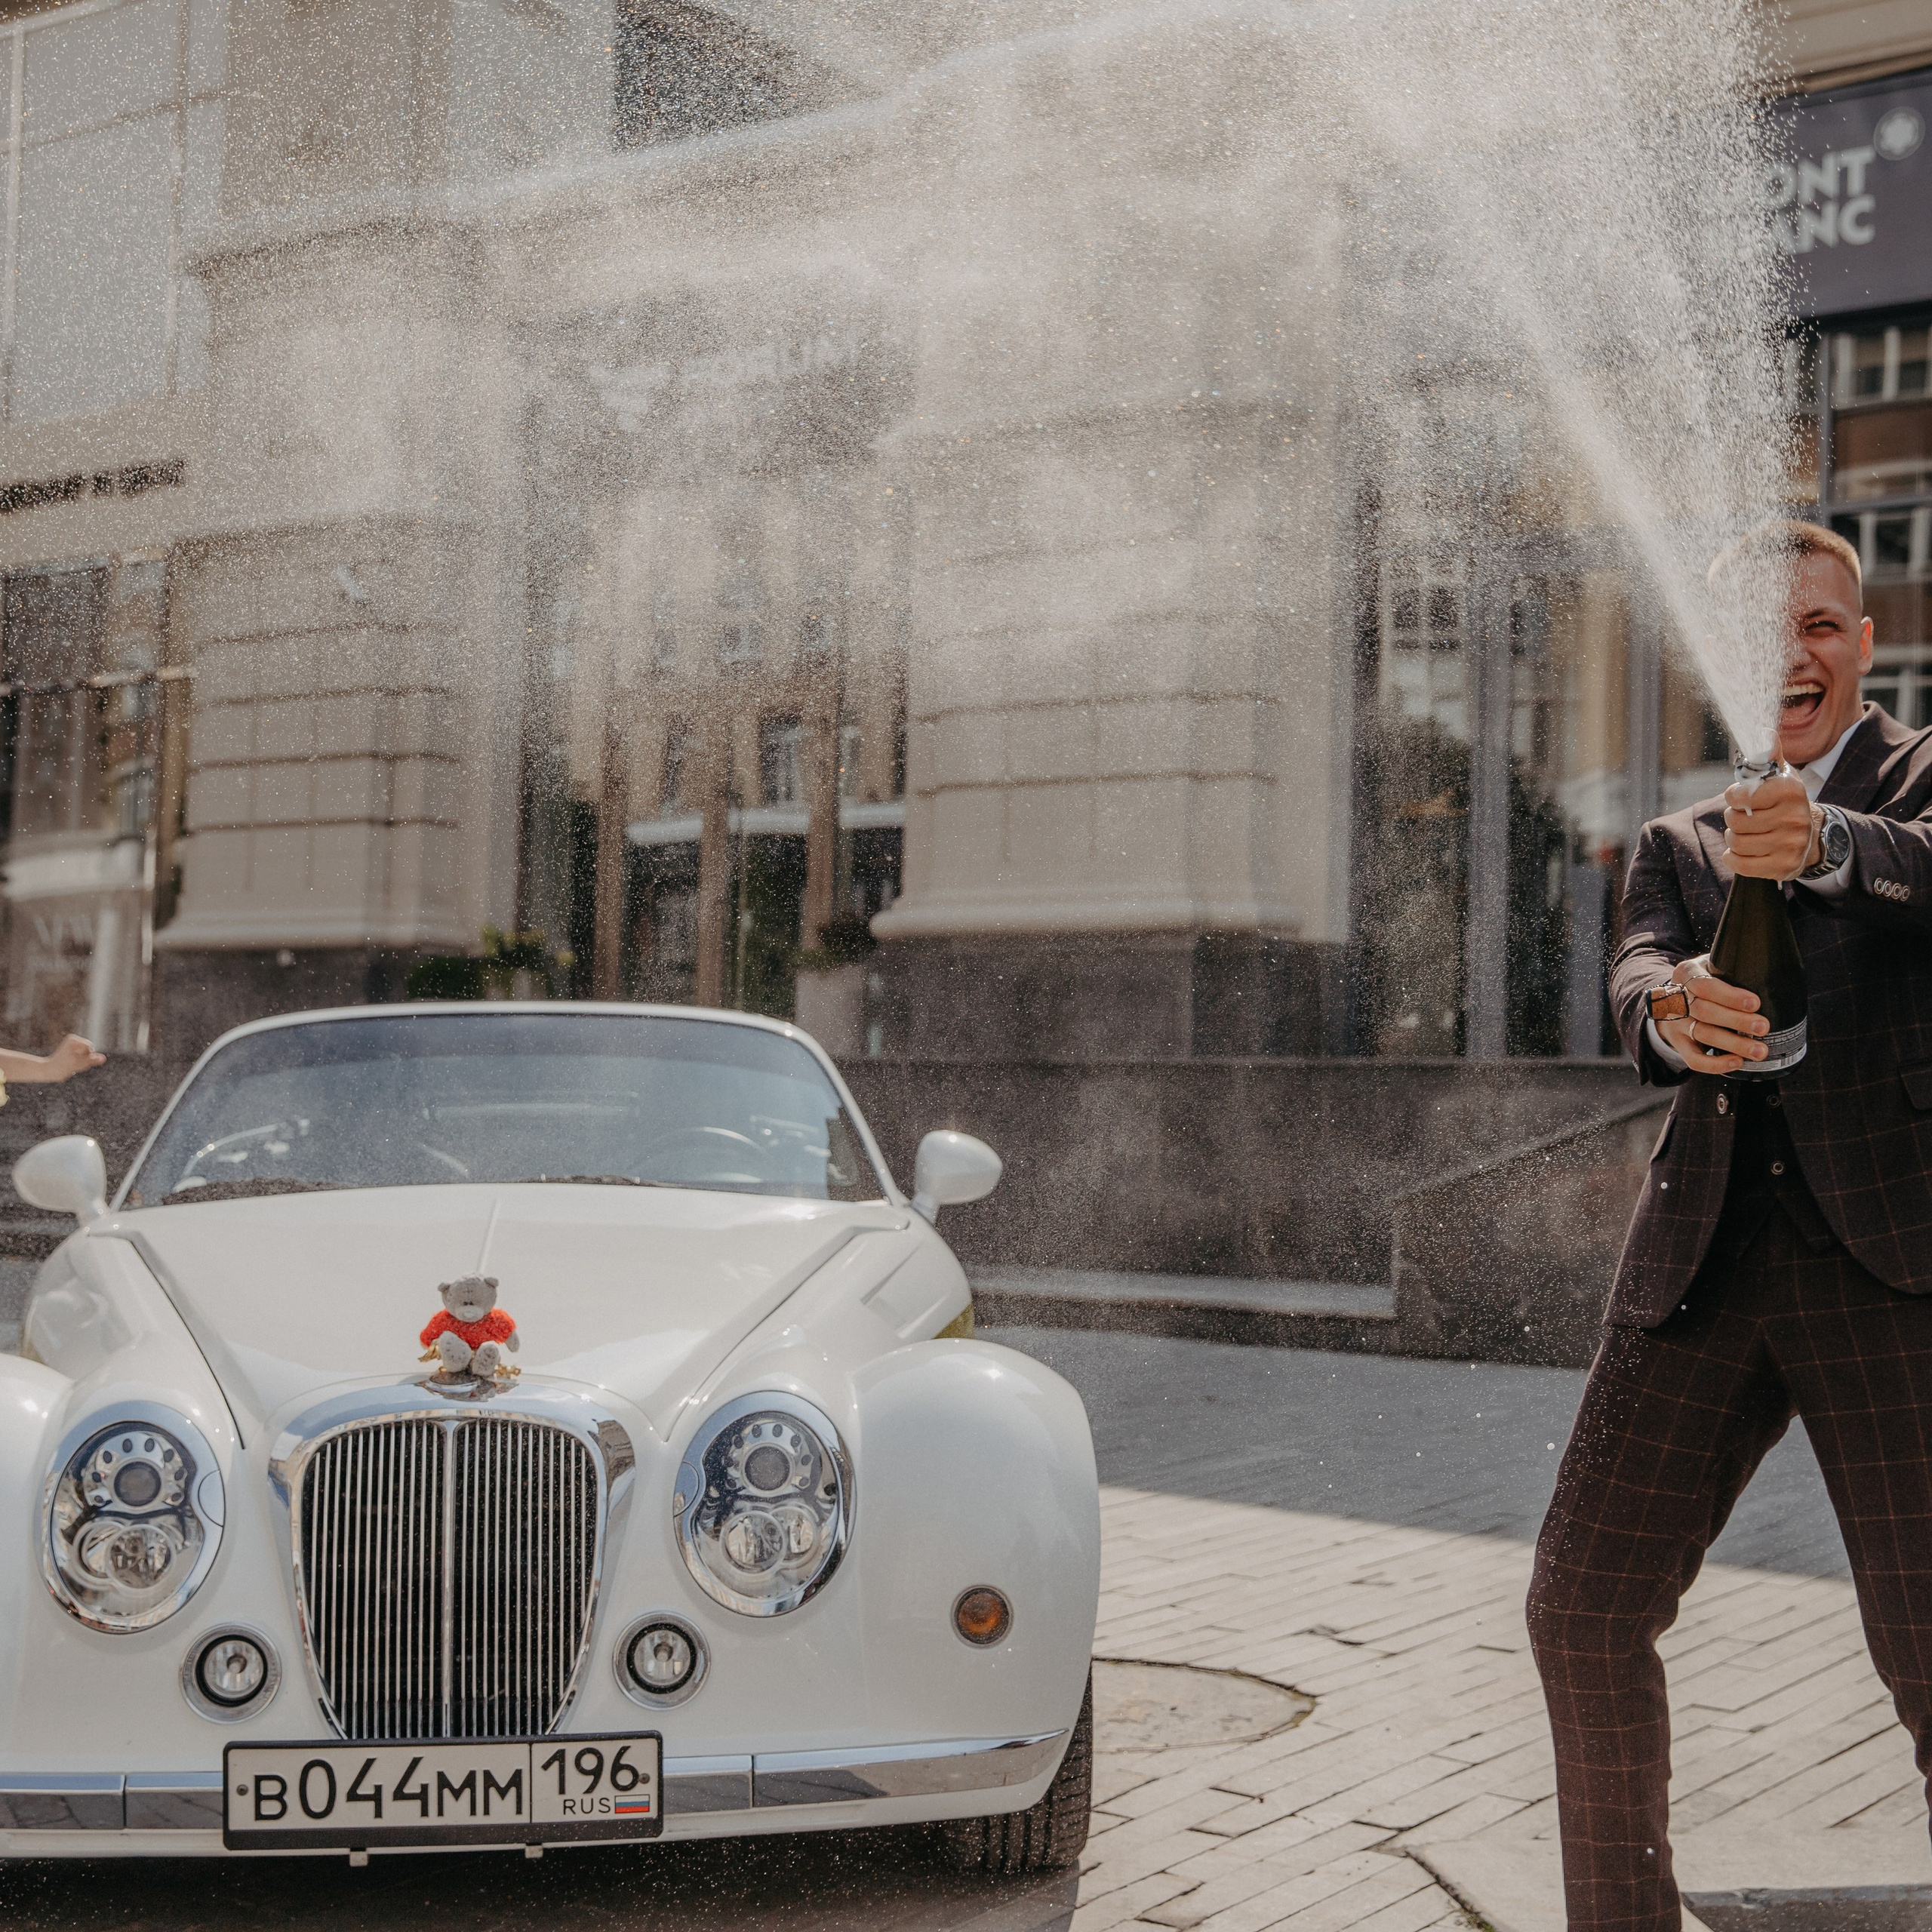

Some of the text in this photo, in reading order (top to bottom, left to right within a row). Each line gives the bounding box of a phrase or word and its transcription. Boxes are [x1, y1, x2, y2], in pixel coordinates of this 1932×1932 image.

[1761, 145, 1878, 209] ONT
[1767, 194, 1877, 255] ANC
[540, 1745, 639, 1795] 196
[563, 1797, 611, 1816] RUS
